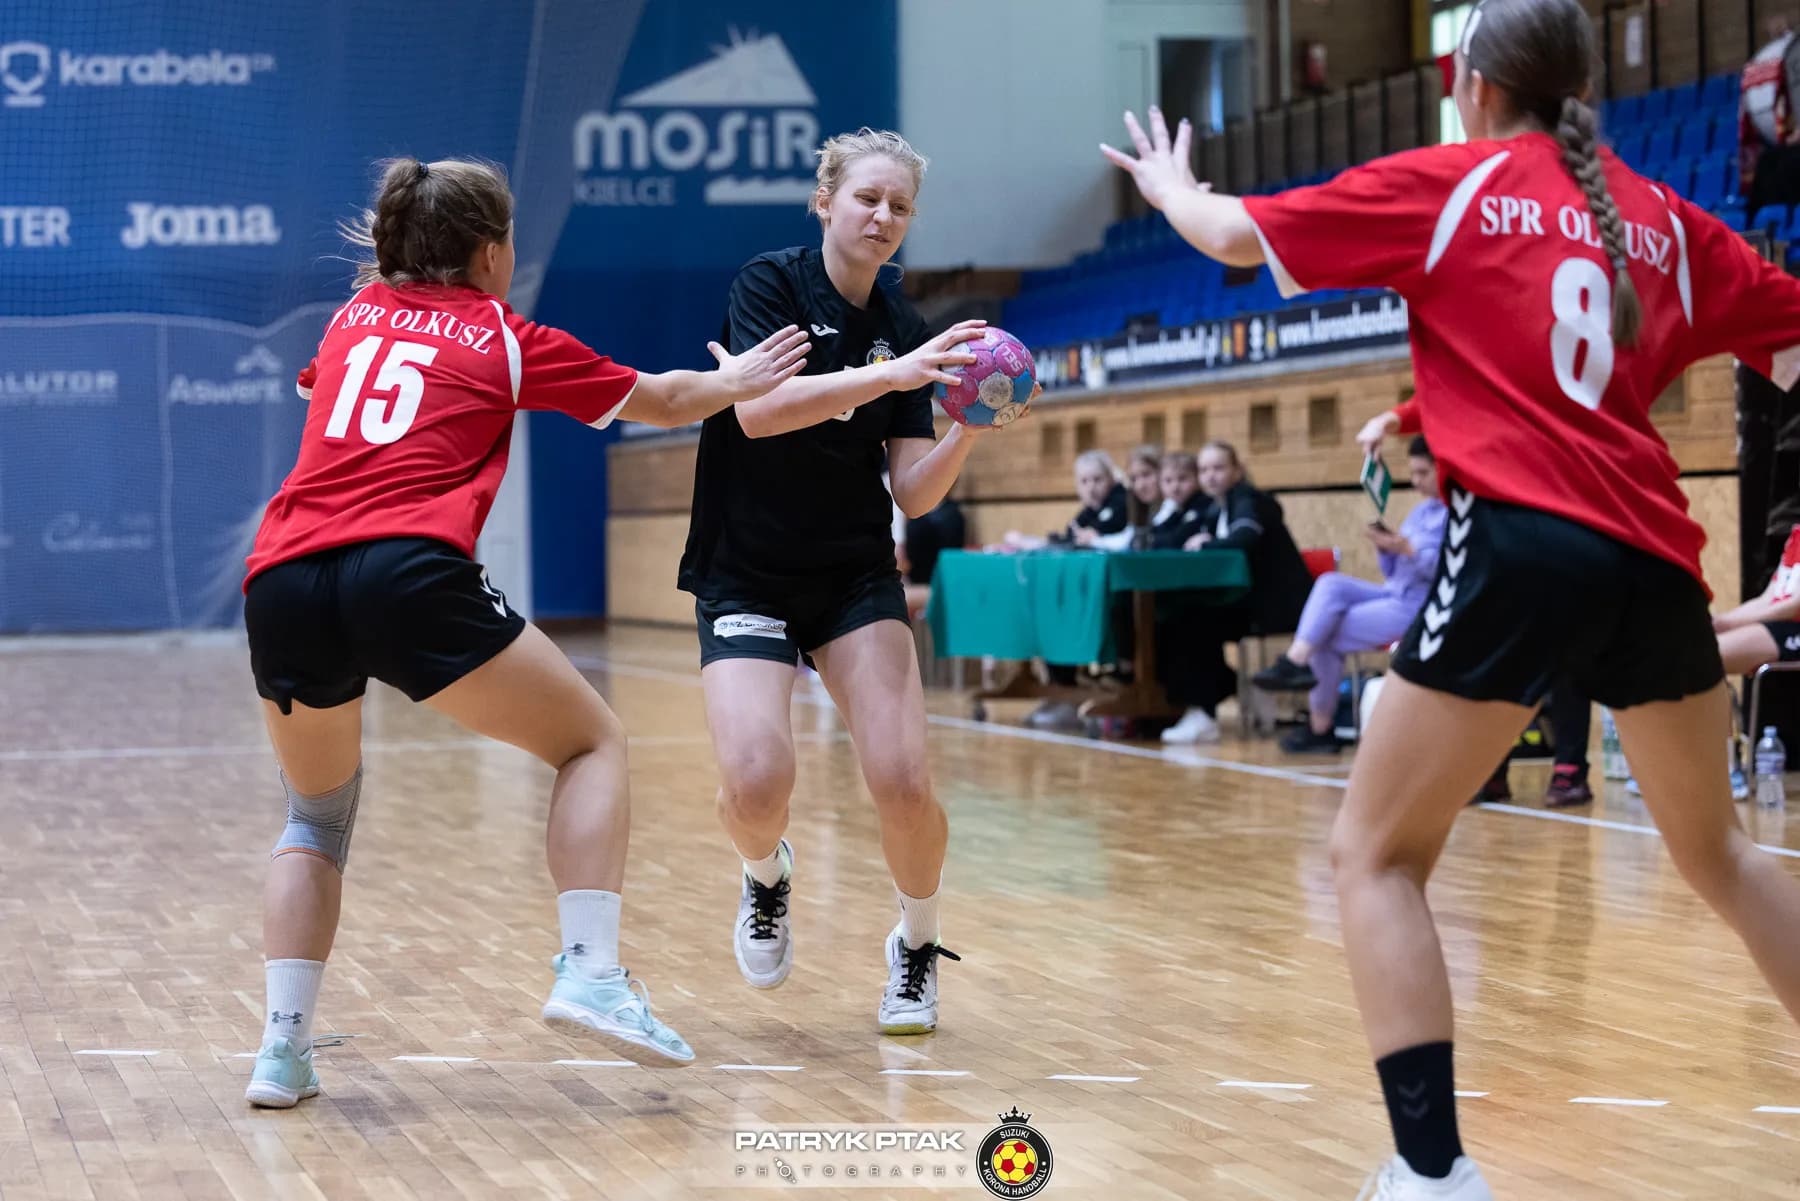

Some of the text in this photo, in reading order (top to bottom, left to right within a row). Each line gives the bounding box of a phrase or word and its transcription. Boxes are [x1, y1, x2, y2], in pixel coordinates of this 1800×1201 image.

[59, 50, 250, 86] karabela
[573, 177, 674, 204] KIELCE
[121, 201, 281, 248] Joma
[1480, 195, 1672, 275] SPR OLUSZ
[341, 303, 495, 355] SPR OLKUSZ
[1551, 256, 1615, 411] 8
[324, 335, 439, 445] 15
